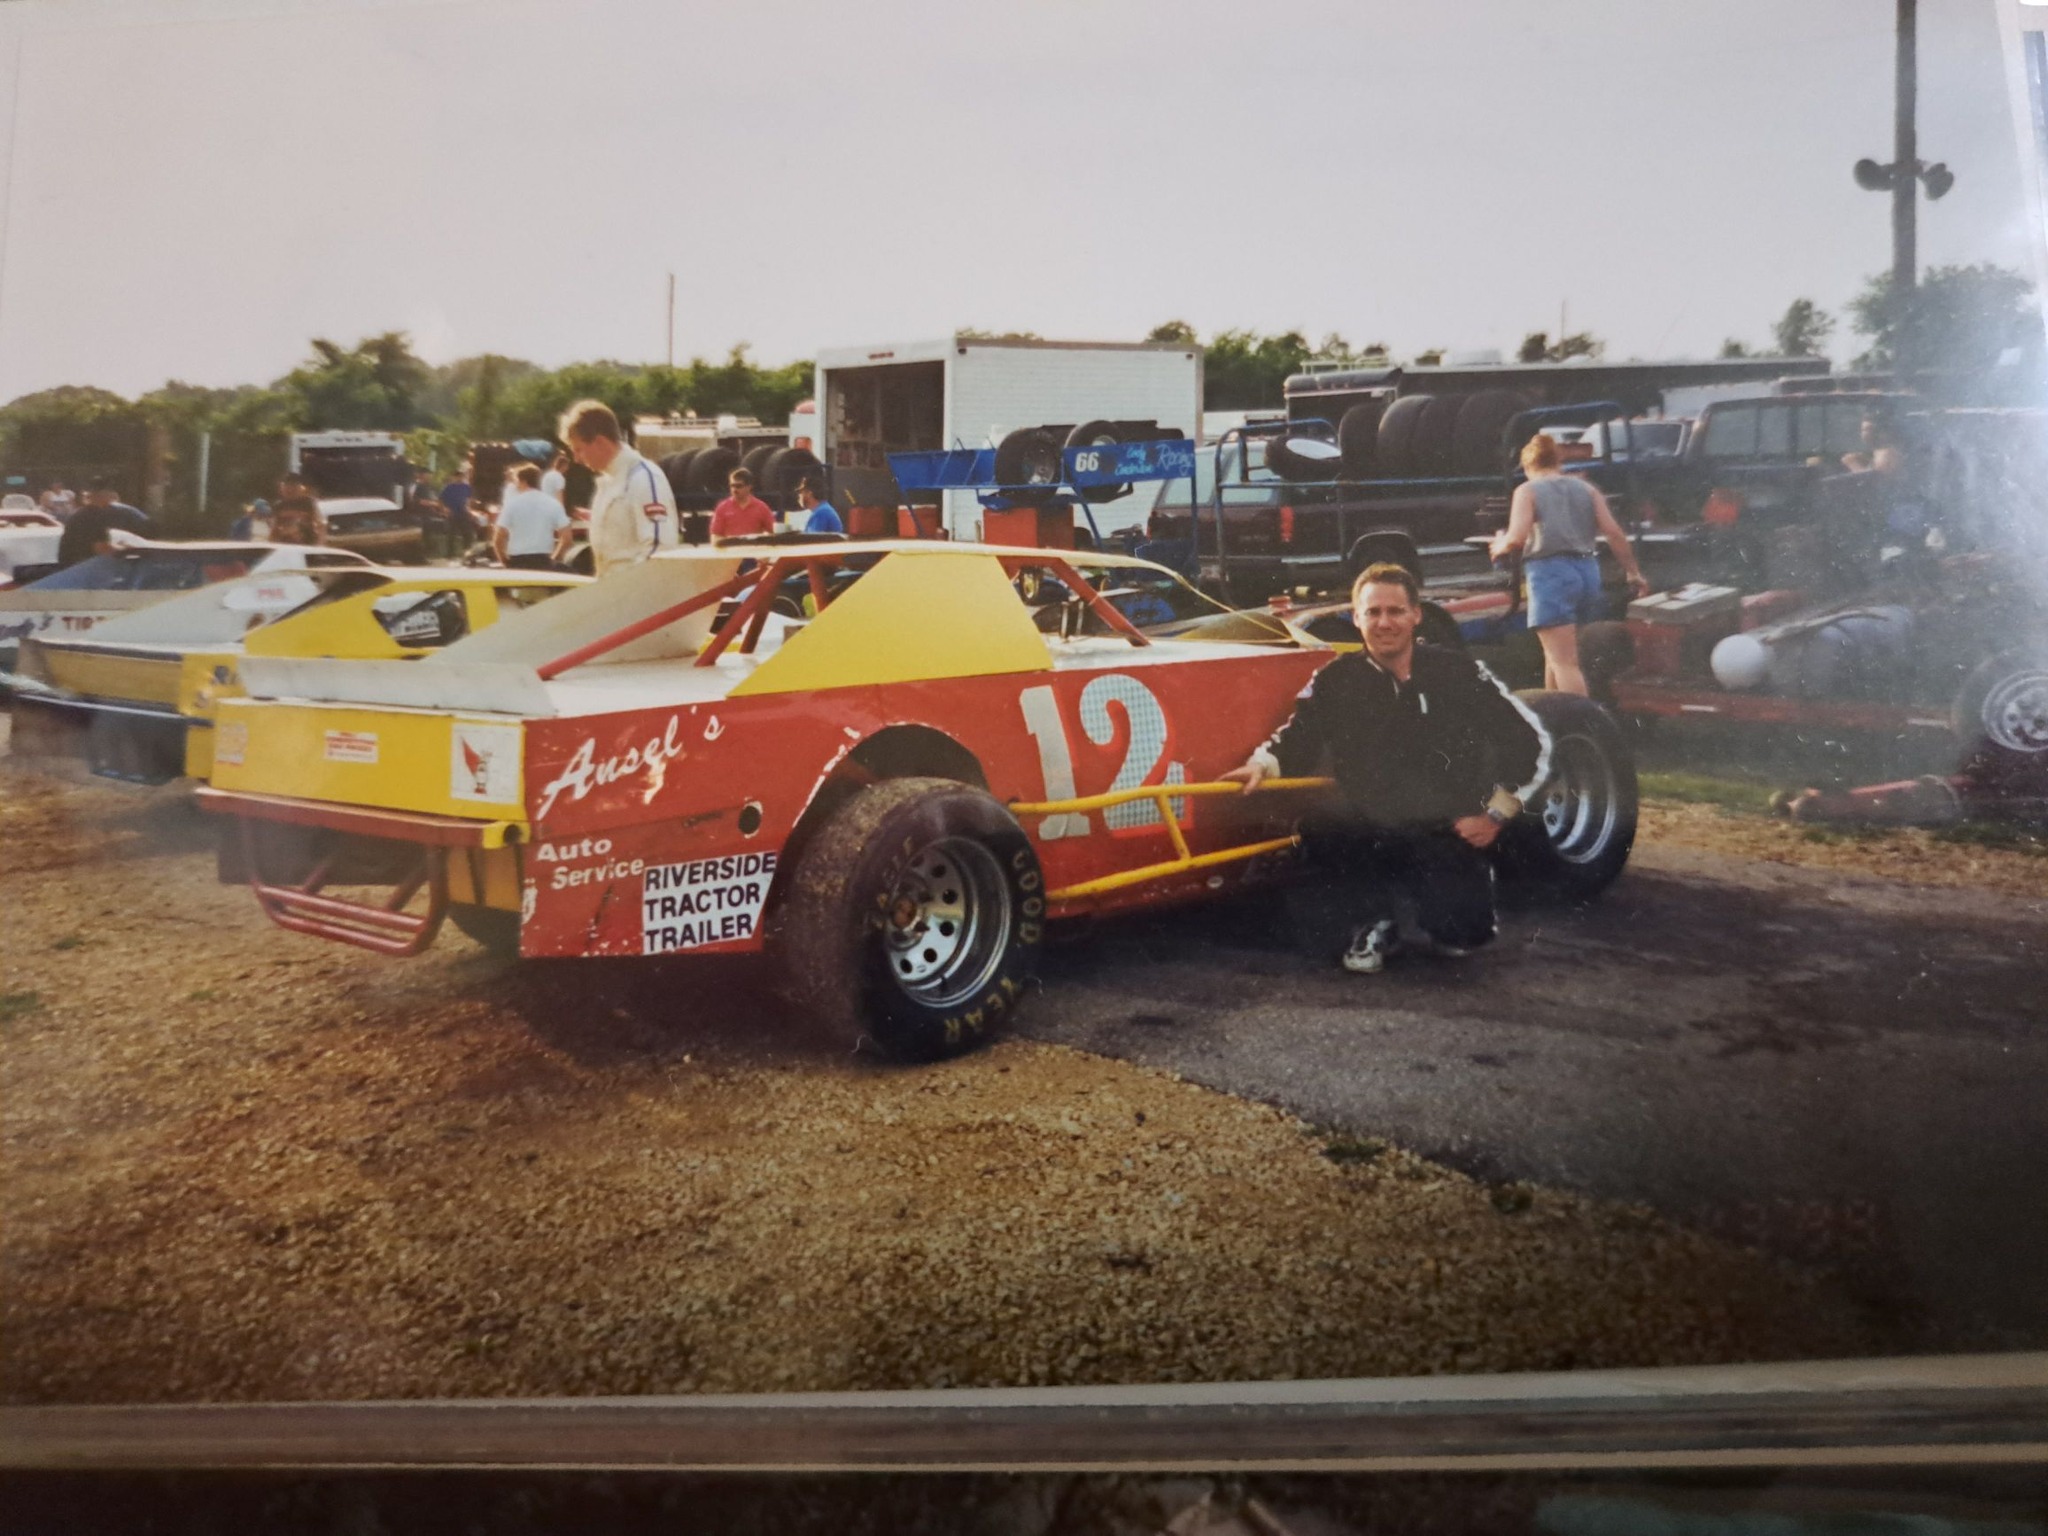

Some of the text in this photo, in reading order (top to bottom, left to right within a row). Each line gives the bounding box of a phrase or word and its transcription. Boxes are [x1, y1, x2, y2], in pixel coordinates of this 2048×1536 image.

[1075, 451, 1099, 473] 66
[535, 705, 726, 821] Ansel's
[1019, 673, 1185, 840] 12
[536, 838, 612, 862] Auto
[551, 857, 645, 890] Service
[645, 851, 778, 892] RIVERSIDE
[644, 882, 761, 922] TRACTOR
[645, 913, 753, 951] TRAILER
